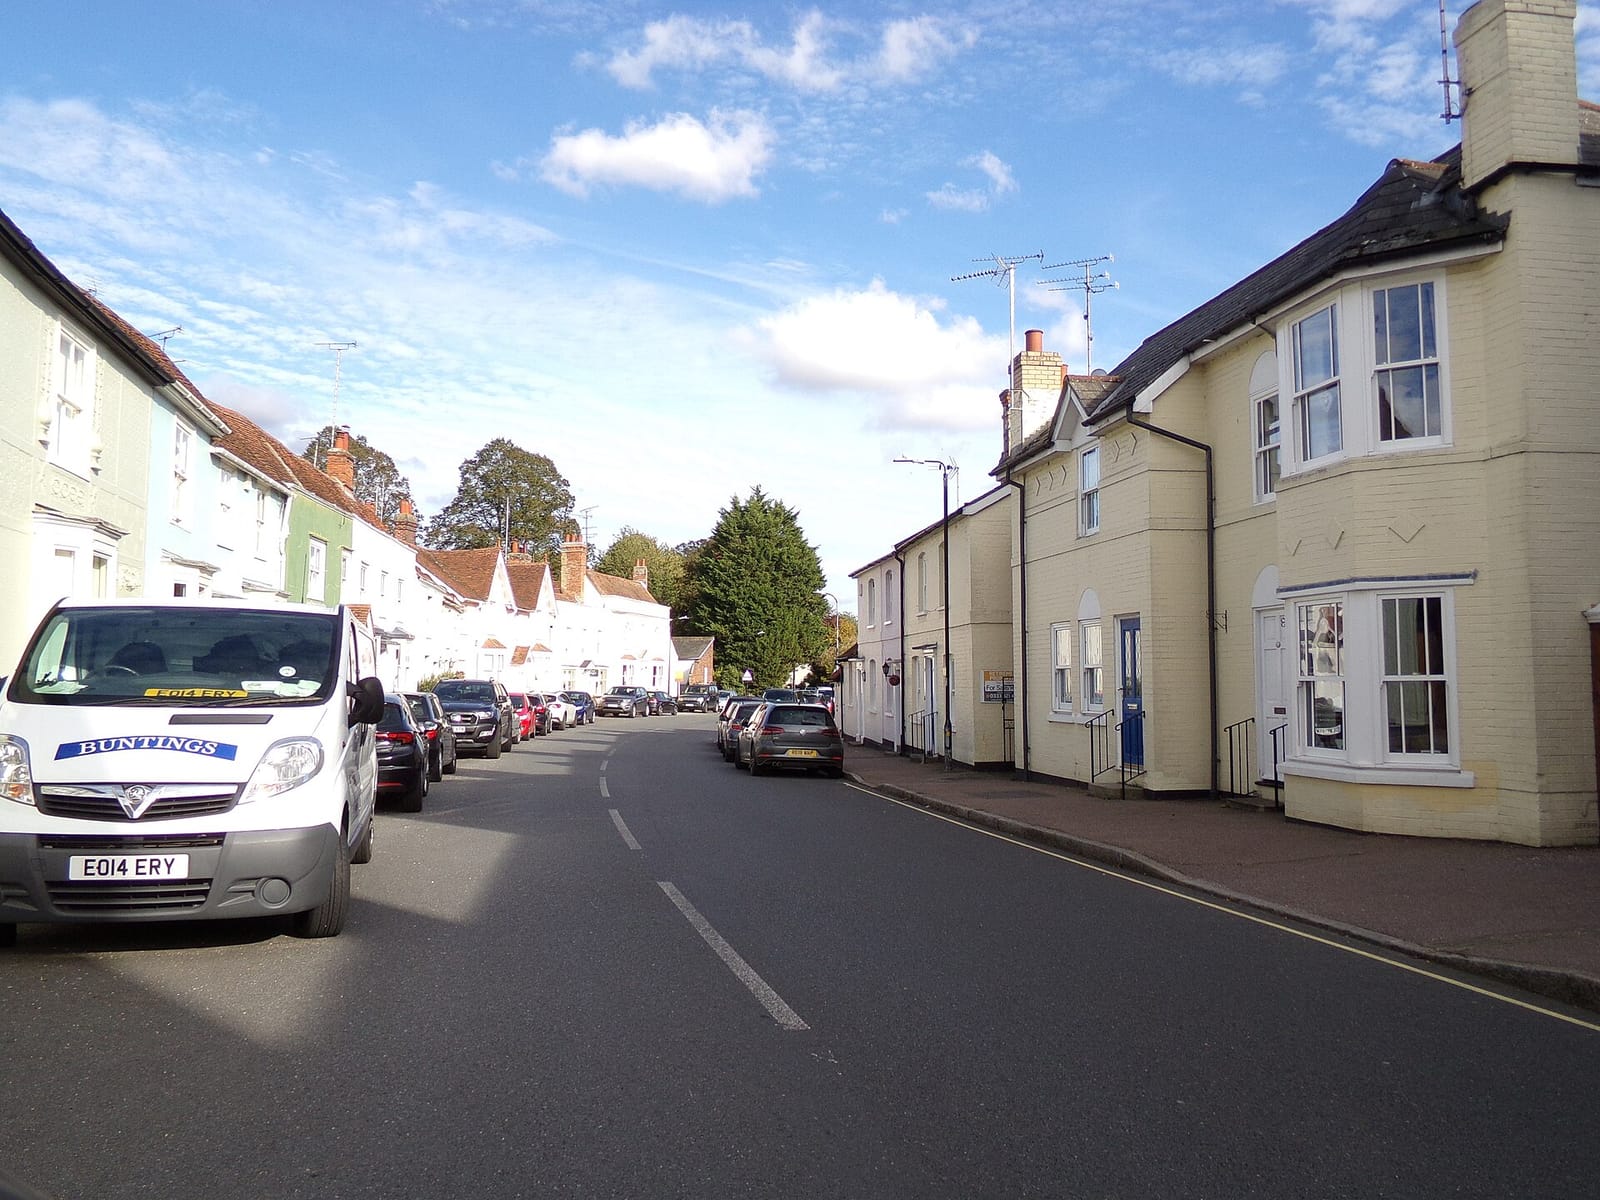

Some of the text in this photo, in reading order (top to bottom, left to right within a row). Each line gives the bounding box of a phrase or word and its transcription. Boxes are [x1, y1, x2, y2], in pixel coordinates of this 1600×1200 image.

[157, 689, 237, 697] EO14 ERY
[78, 736, 218, 755] BUNTINGS
[83, 858, 175, 876] EO14 ERY
